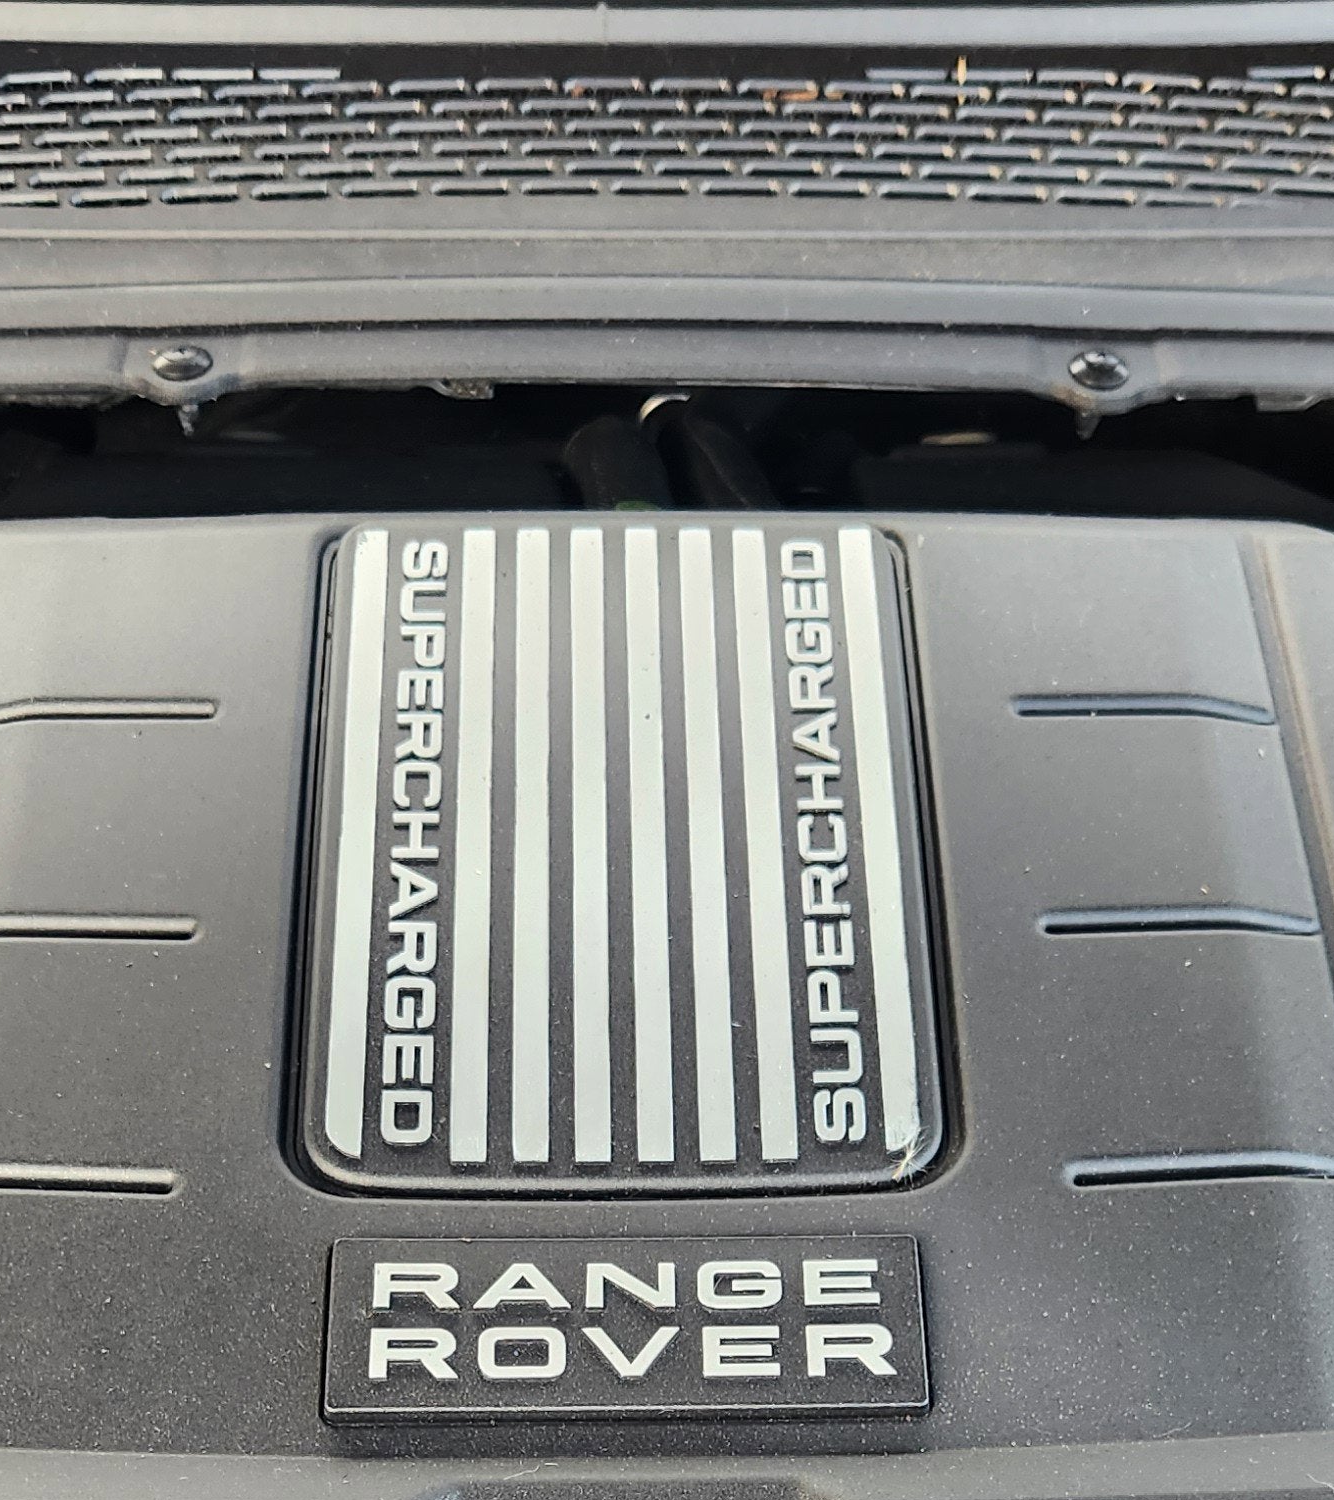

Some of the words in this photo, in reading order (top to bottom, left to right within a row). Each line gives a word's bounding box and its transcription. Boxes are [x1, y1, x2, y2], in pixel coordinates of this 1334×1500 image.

[379, 538, 450, 1148] SUPERCHARGED
[779, 539, 868, 1144] SUPERCHARGED
[367, 1322, 899, 1381] ROVER
[371, 1258, 882, 1311] RANGE
